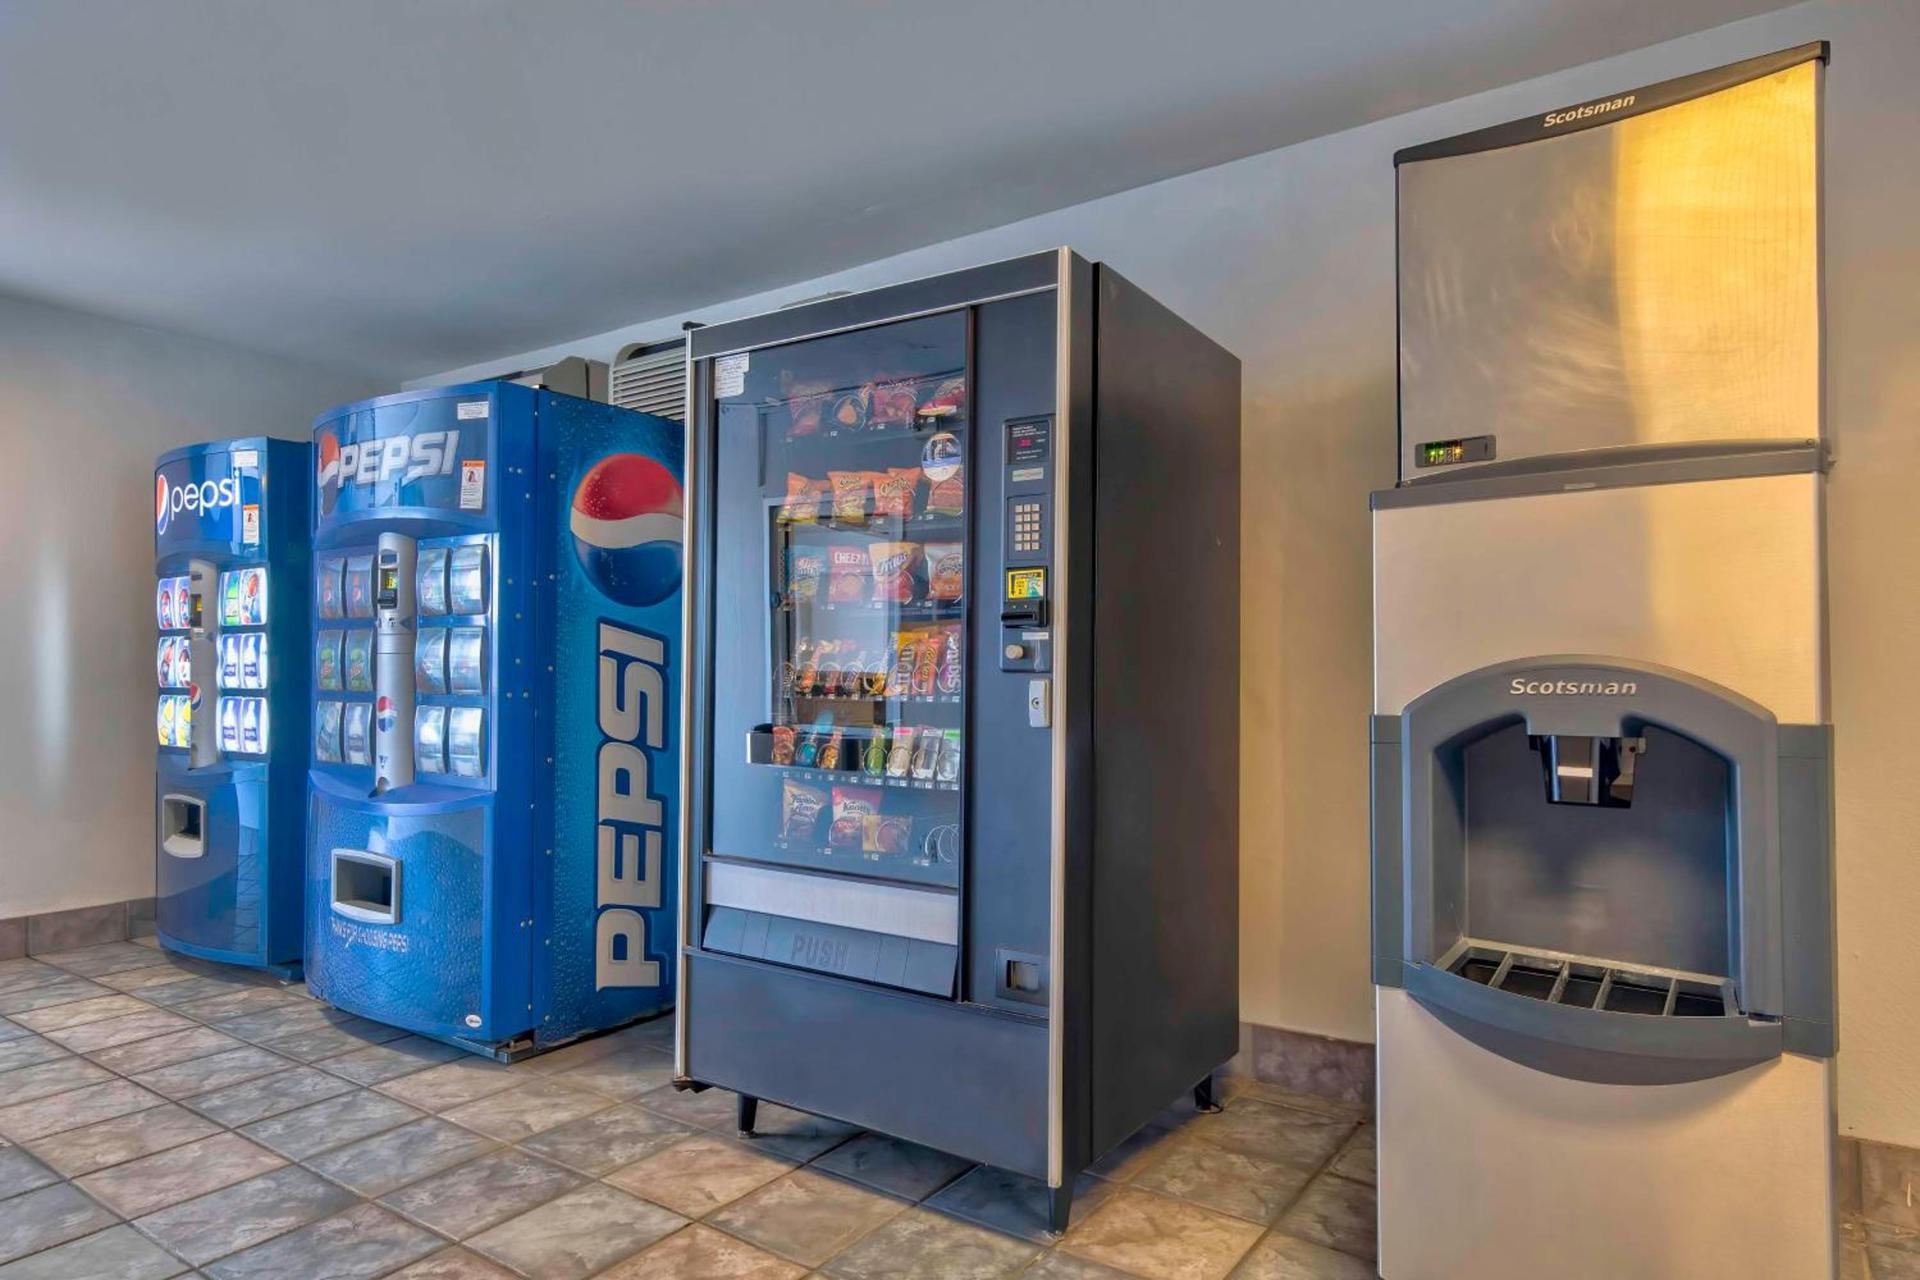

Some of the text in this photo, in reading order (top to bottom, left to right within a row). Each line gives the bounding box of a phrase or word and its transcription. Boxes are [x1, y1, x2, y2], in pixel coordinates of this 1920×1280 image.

[1543, 95, 1636, 128] Scotsman
[337, 430, 460, 488] PEPSI
[171, 469, 240, 521] pepsi
[1509, 678, 1637, 695] Scotsman
[596, 622, 664, 991] PEPSI
[791, 934, 849, 970] PUSH
